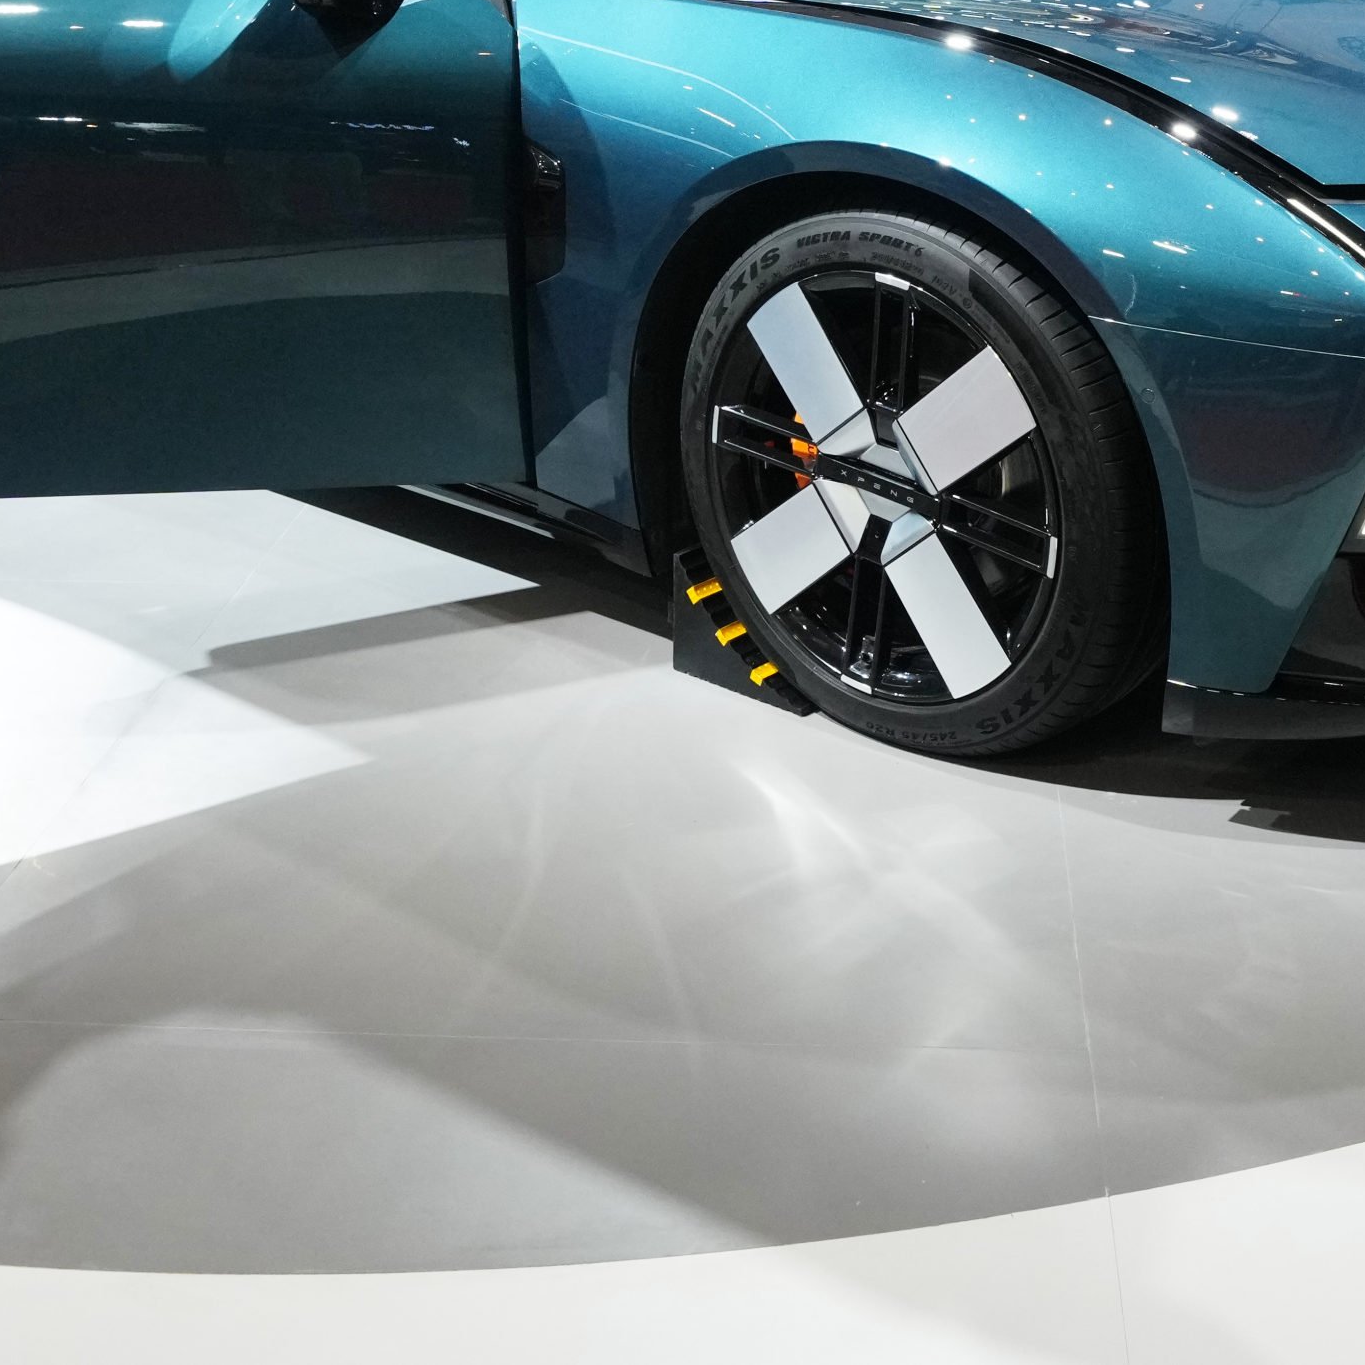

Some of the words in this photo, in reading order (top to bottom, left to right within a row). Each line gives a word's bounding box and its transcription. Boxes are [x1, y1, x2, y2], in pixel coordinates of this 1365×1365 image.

[796, 230, 851, 248] VICTRA
[858, 231, 914, 252] SPORT
[840, 469, 914, 504] XPENG
